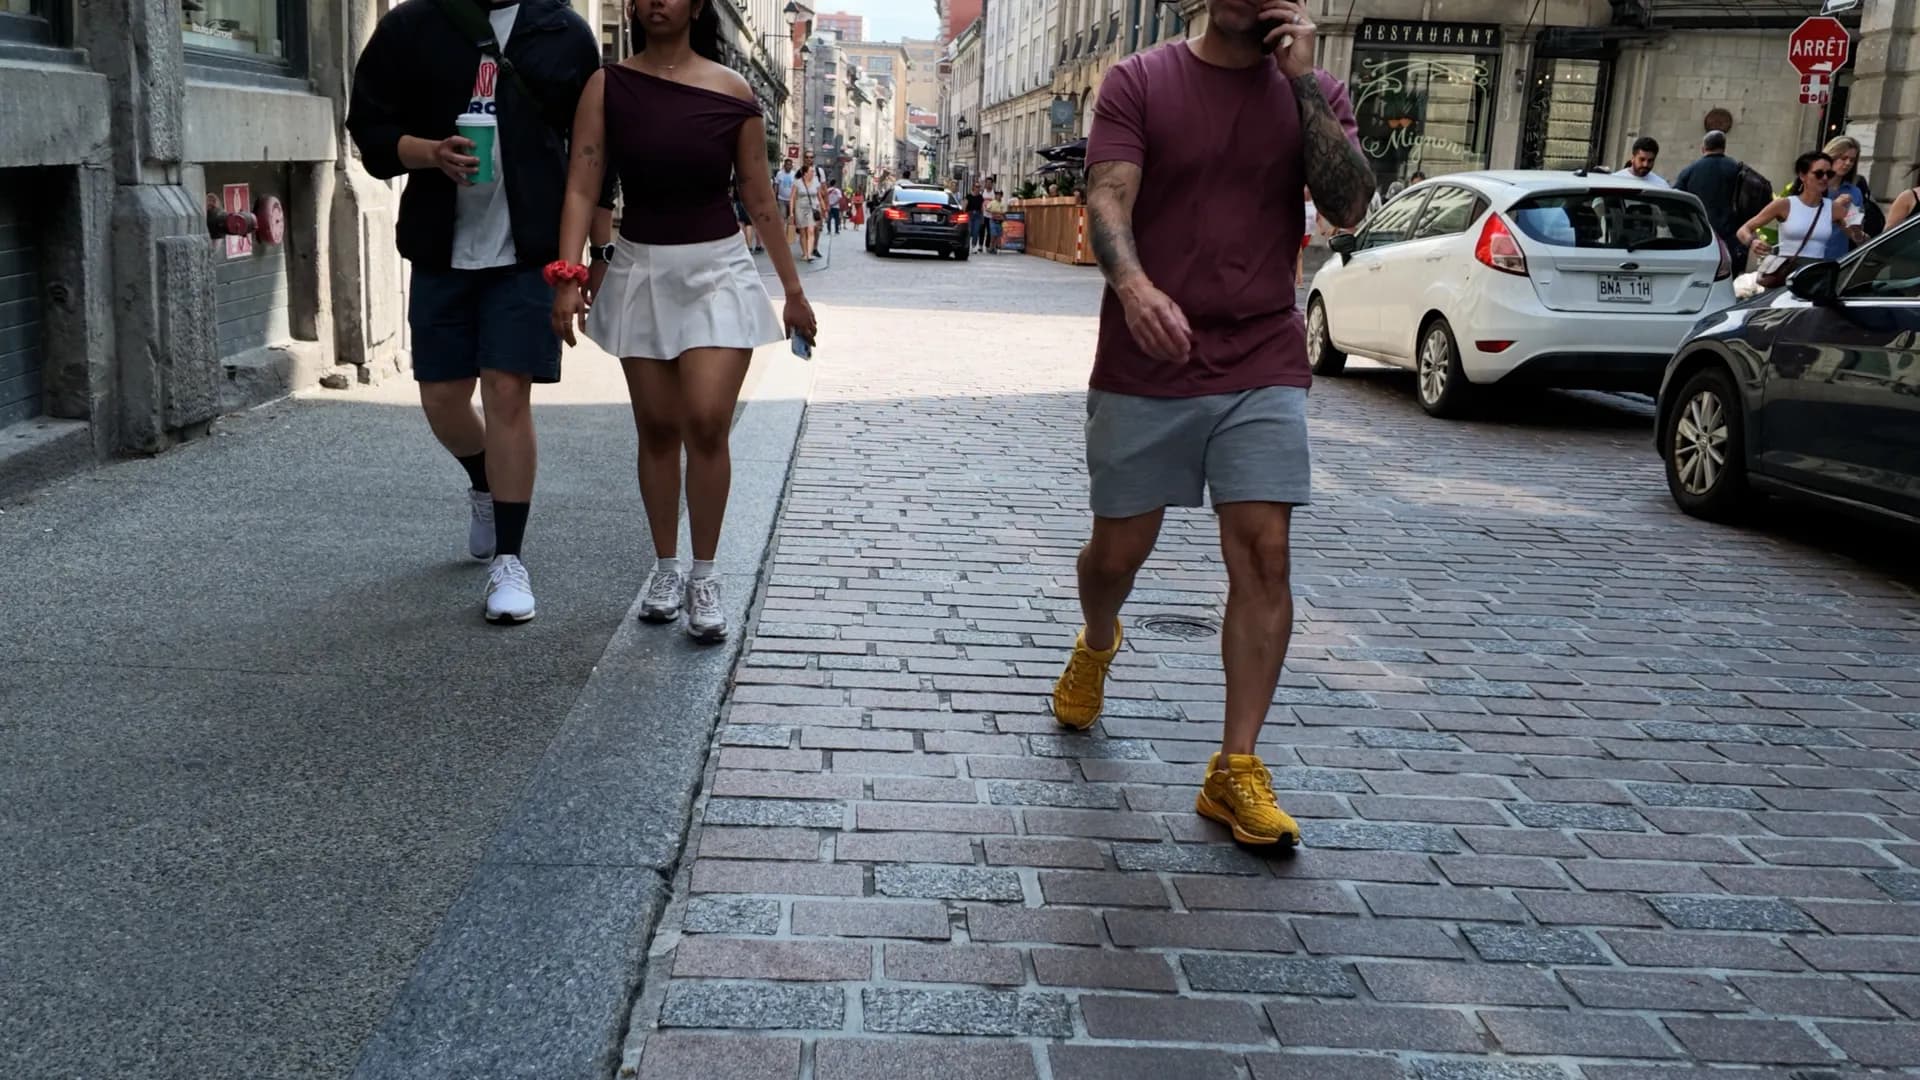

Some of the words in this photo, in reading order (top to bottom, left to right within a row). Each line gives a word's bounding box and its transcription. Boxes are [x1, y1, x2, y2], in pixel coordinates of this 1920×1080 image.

[1364, 24, 1494, 45] RESTAURANT
[1791, 36, 1846, 57] ARRÊT
[1362, 126, 1463, 162] Mignon
[1600, 280, 1622, 295] BNA
[1629, 281, 1650, 296] 11H
